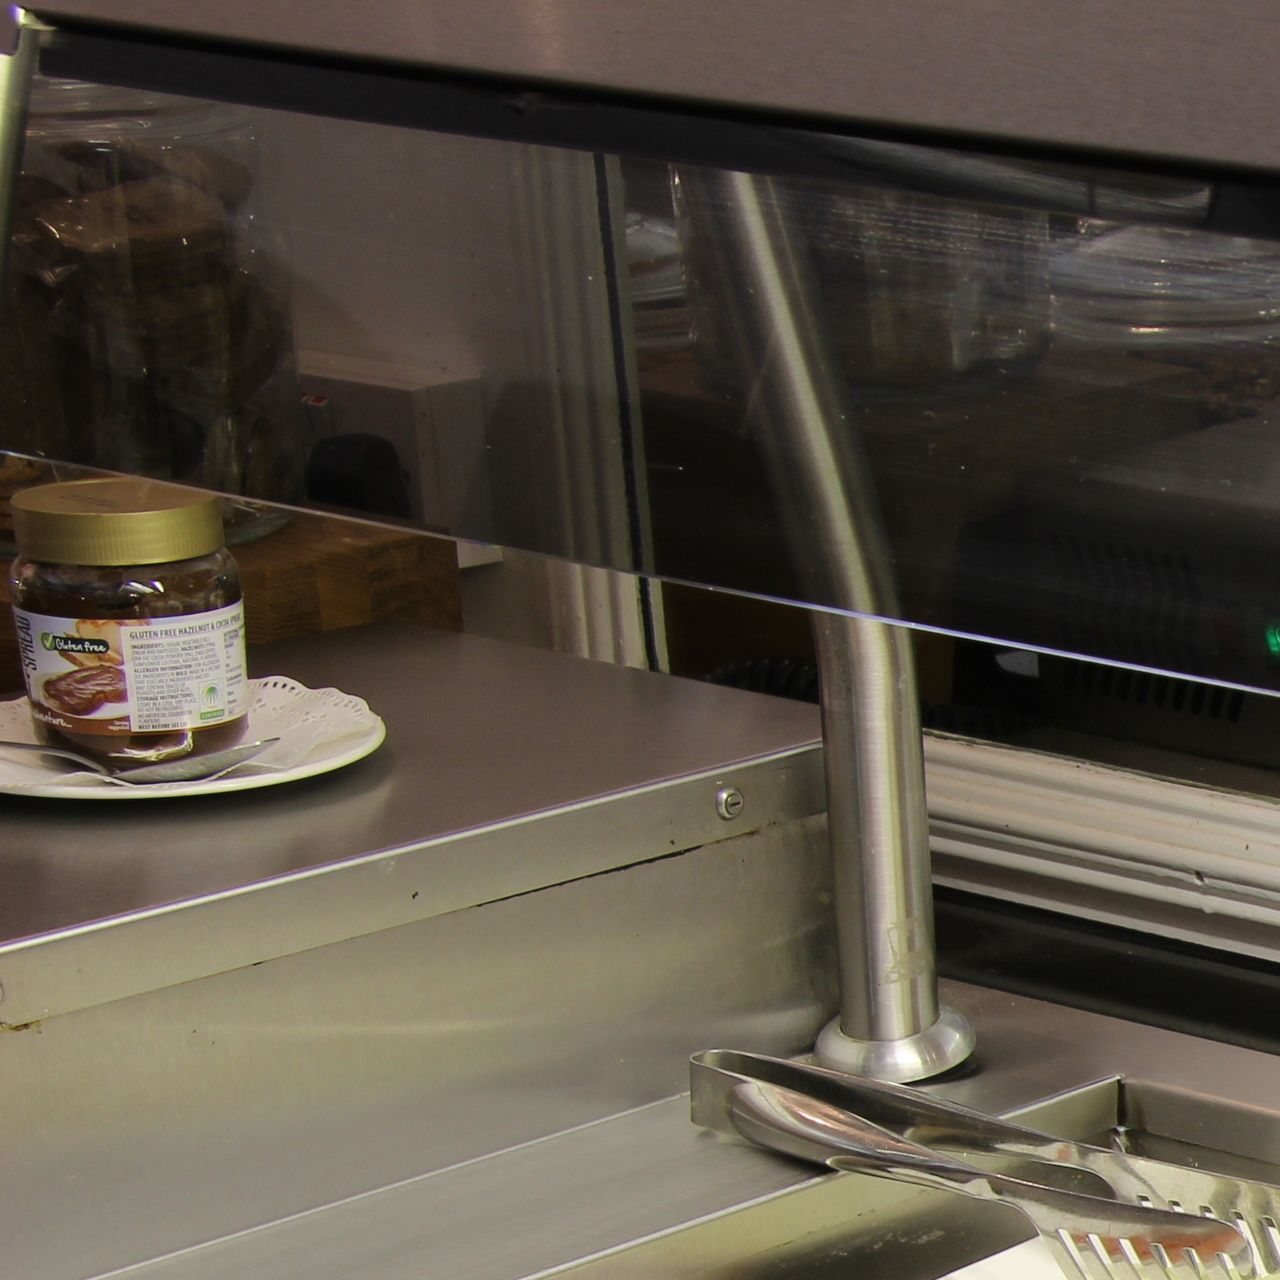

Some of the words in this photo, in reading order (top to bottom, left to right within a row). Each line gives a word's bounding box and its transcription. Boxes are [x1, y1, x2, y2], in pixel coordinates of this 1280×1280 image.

[129, 630, 158, 640] GLUTEN
[160, 628, 177, 639] FREE
[178, 624, 210, 637] HAZELNUT
